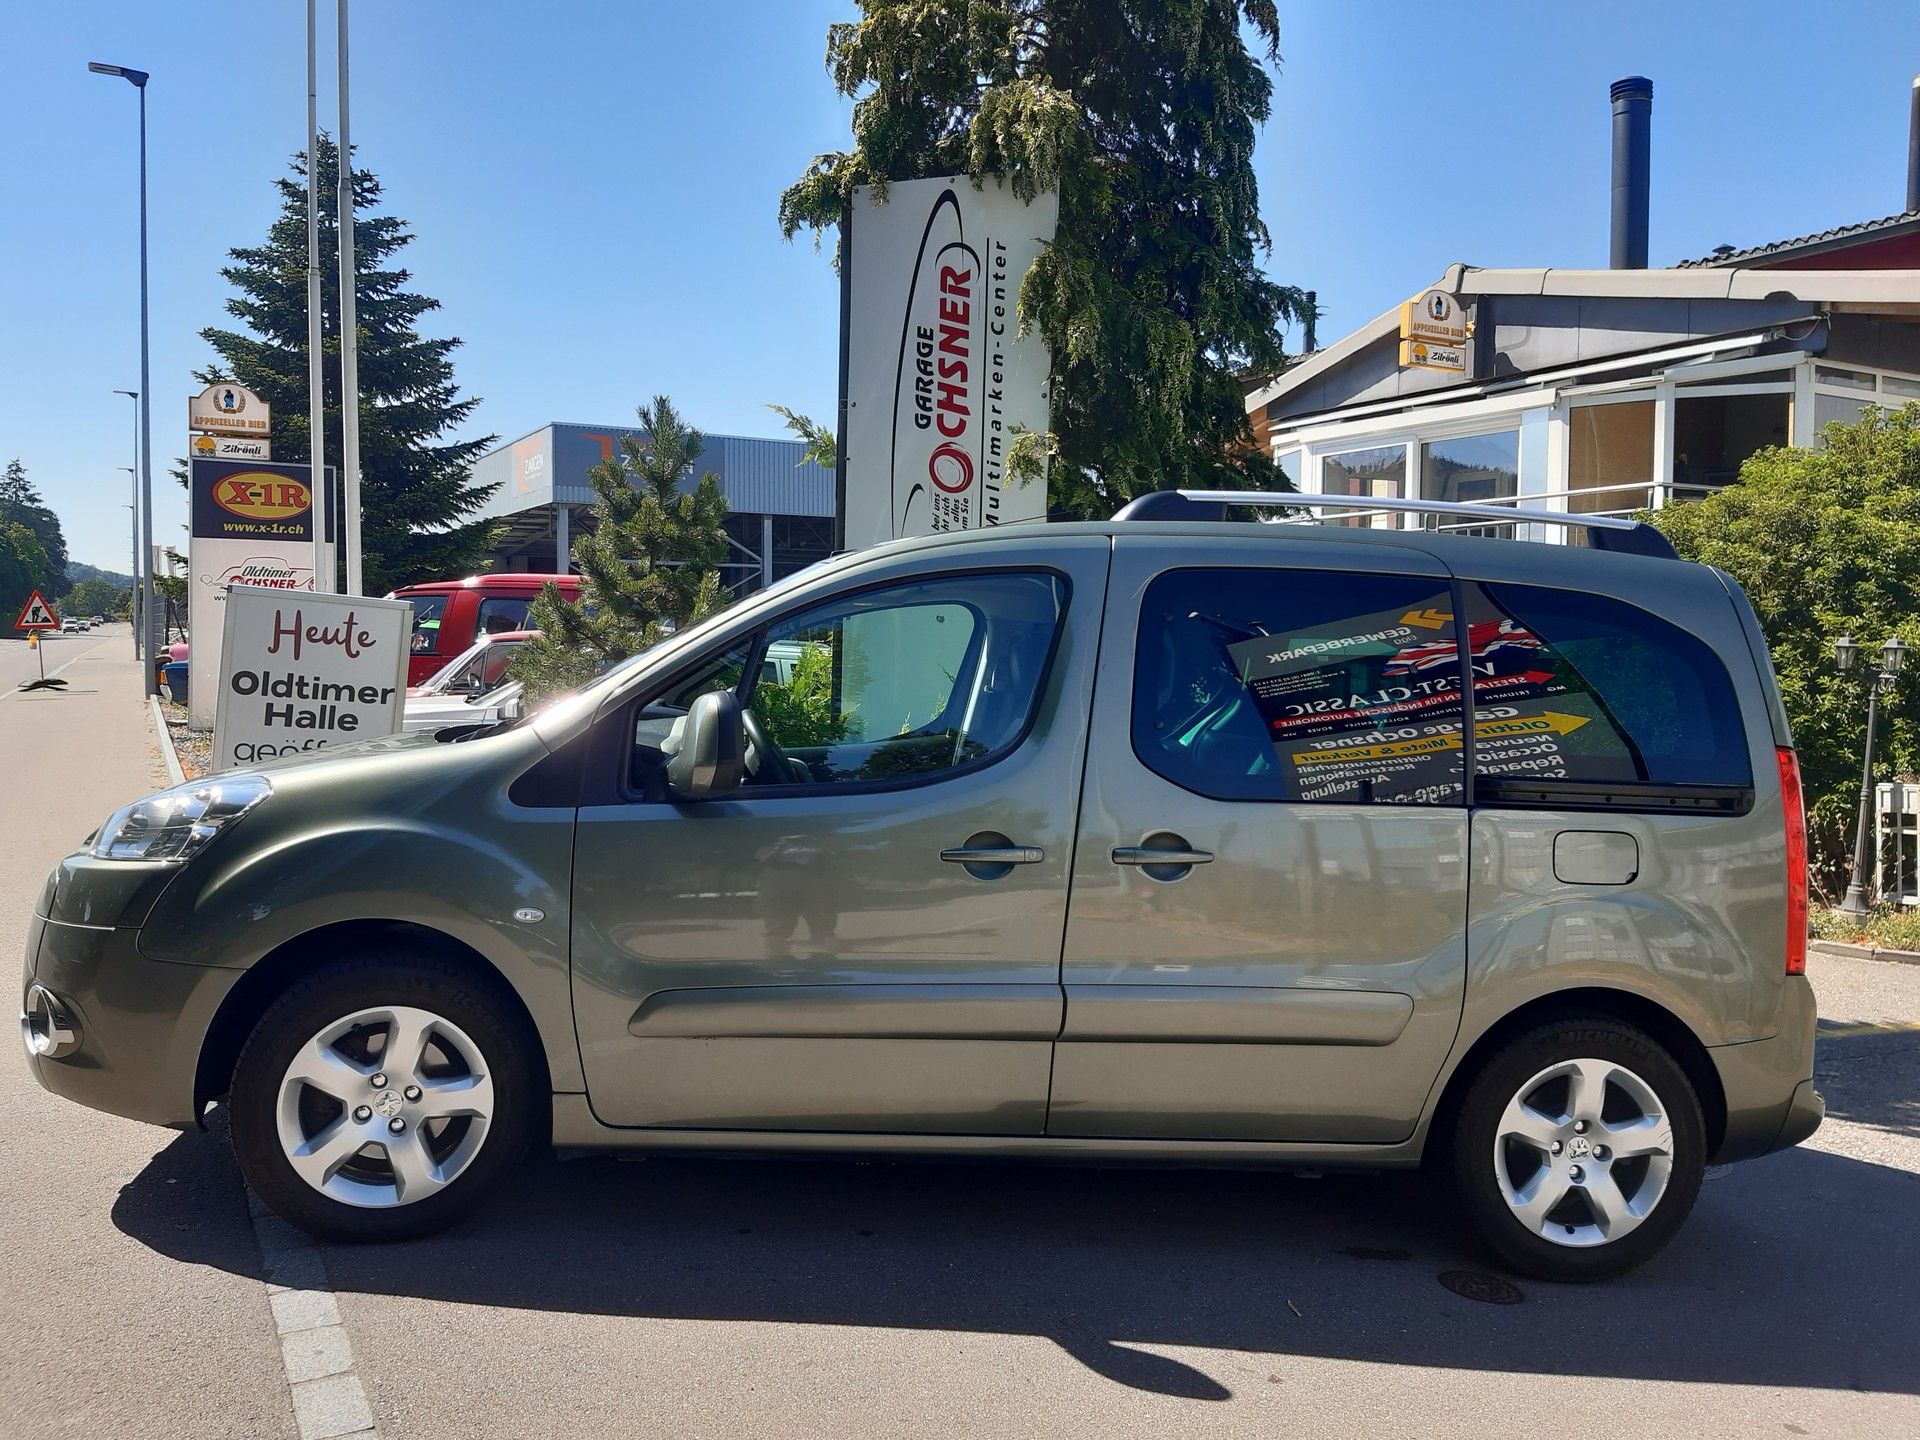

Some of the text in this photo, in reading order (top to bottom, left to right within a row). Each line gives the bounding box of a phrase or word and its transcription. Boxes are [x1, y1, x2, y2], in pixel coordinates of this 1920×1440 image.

[1413, 322, 1464, 338] APPENZELLER BIER
[914, 325, 934, 430] GARAGE
[985, 240, 1009, 527] Multimarken-Center
[194, 416, 267, 429] APPENZELLER BIER
[221, 444, 262, 454] Zitrönli
[224, 480, 308, 509] X-1R
[941, 497, 950, 517] sich
[960, 497, 969, 515] Sie
[931, 492, 941, 531] bei uns
[951, 498, 960, 523] alles
[222, 521, 305, 536] www.x-1r.ch
[241, 565, 297, 579] Oldtimer
[267, 608, 377, 661] Heute
[231, 670, 396, 706] Oldtimer
[264, 702, 360, 732] Halle
